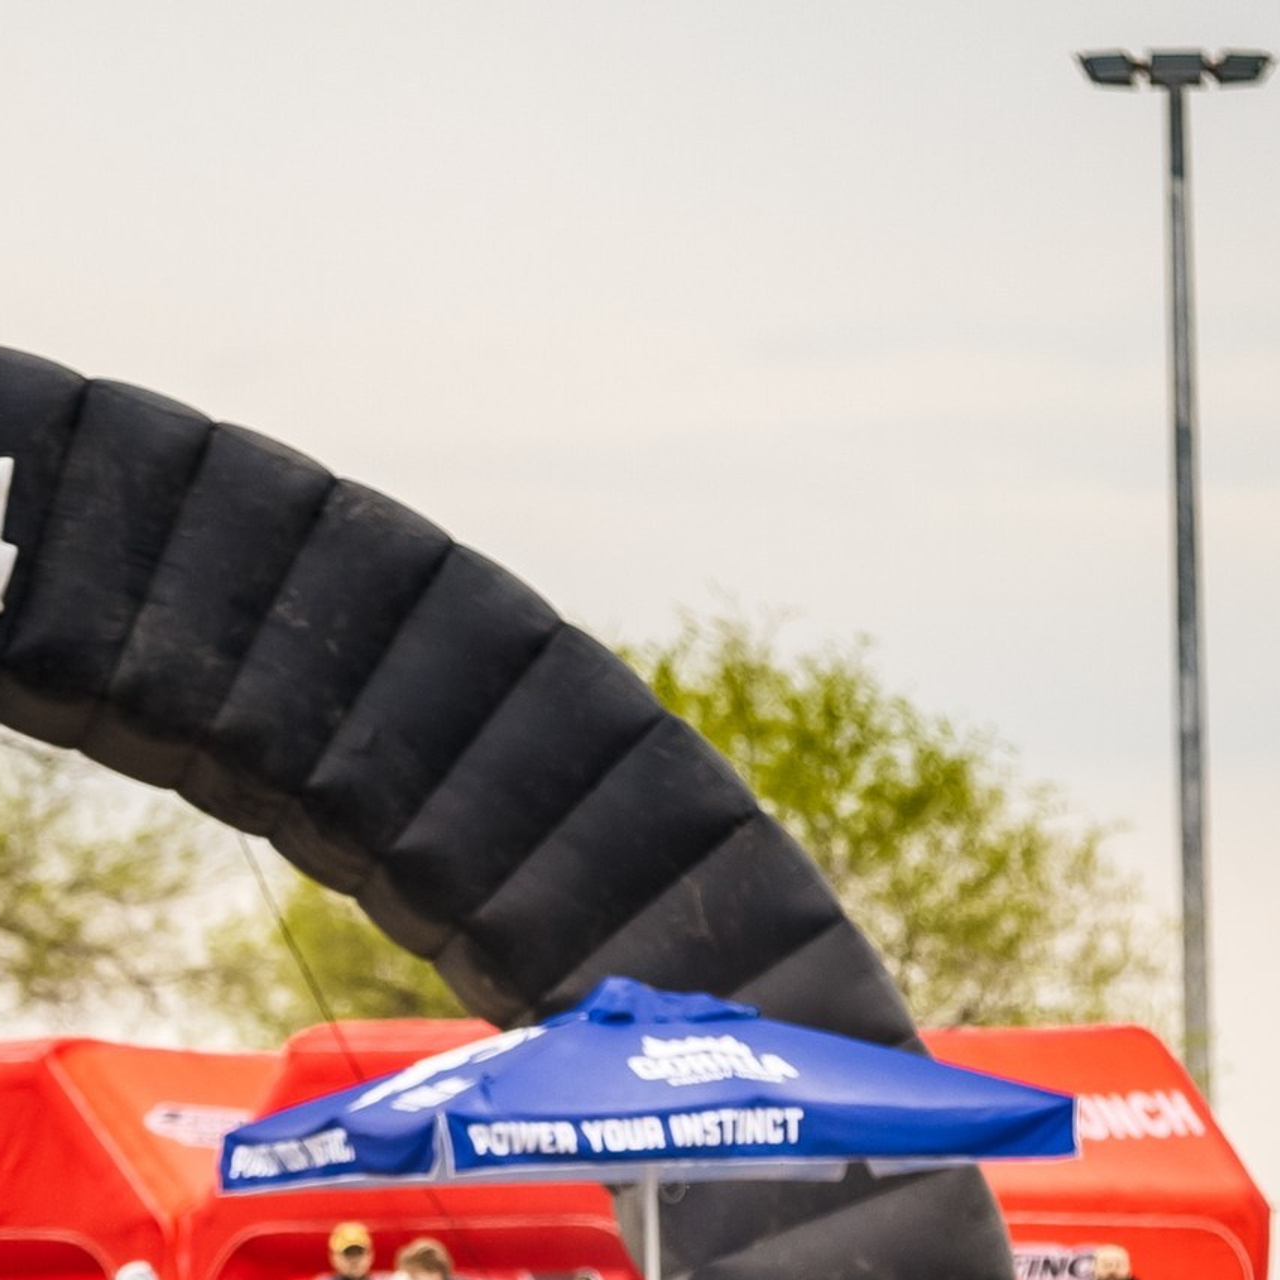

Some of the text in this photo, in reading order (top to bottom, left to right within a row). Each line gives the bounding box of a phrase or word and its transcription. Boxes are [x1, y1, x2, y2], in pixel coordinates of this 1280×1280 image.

[468, 1107, 805, 1156] POWER YOUR INSTINCT
